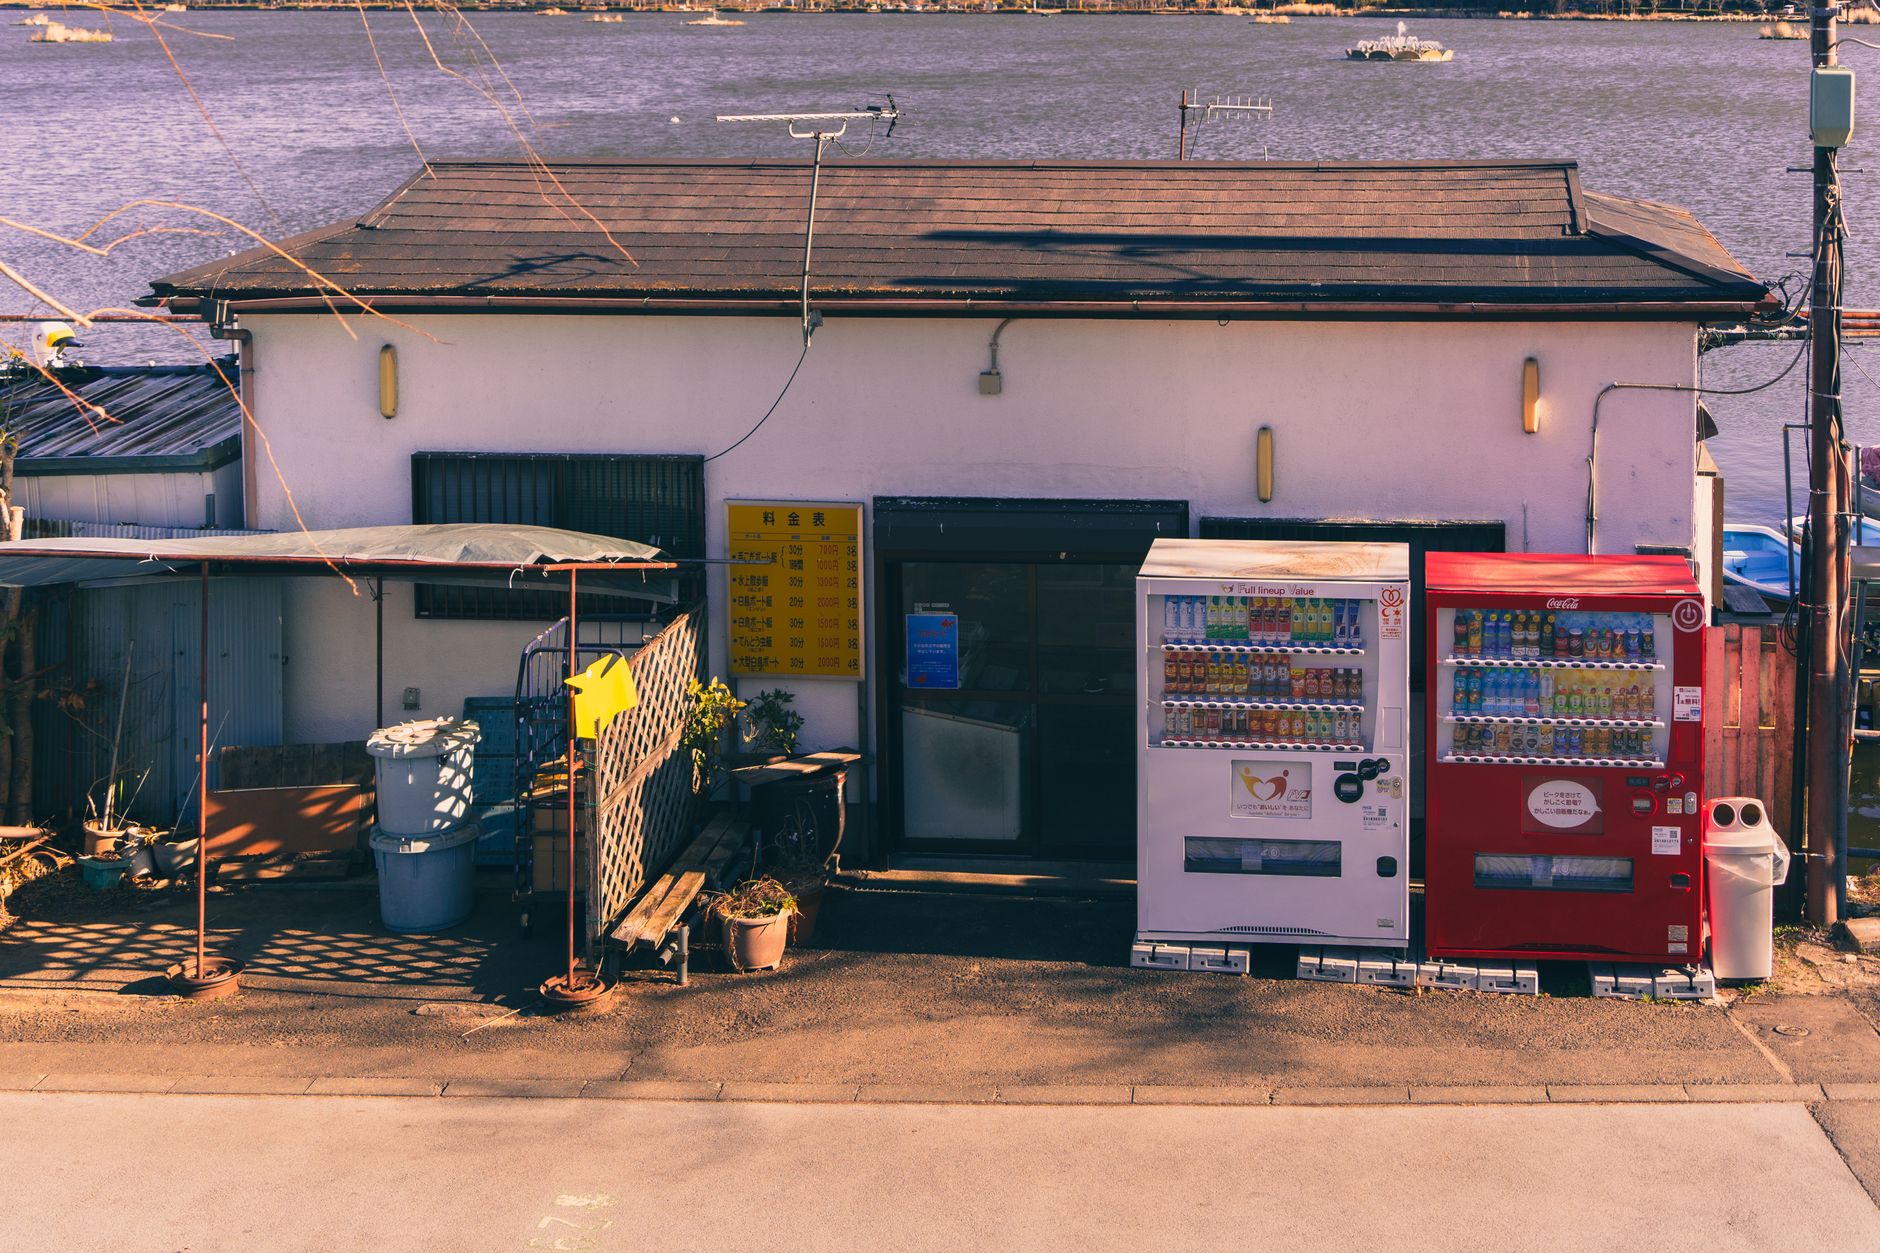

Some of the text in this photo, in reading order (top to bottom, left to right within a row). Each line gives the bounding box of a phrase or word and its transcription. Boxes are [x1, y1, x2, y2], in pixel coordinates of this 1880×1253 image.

[762, 512, 825, 526] 料金表
[788, 545, 803, 556] 30分
[819, 545, 839, 556] 700円
[817, 559, 839, 571] 1000円
[789, 577, 803, 587] 30分
[1238, 583, 1314, 596] Full lineup Value
[789, 597, 803, 608] 20分
[818, 597, 839, 608] 2000円
[790, 618, 804, 628] 30分
[817, 618, 839, 629] 1500円
[790, 637, 804, 648] 30分
[818, 638, 840, 648] 1500円
[790, 657, 804, 668] 30分
[818, 657, 840, 668] 2000円
